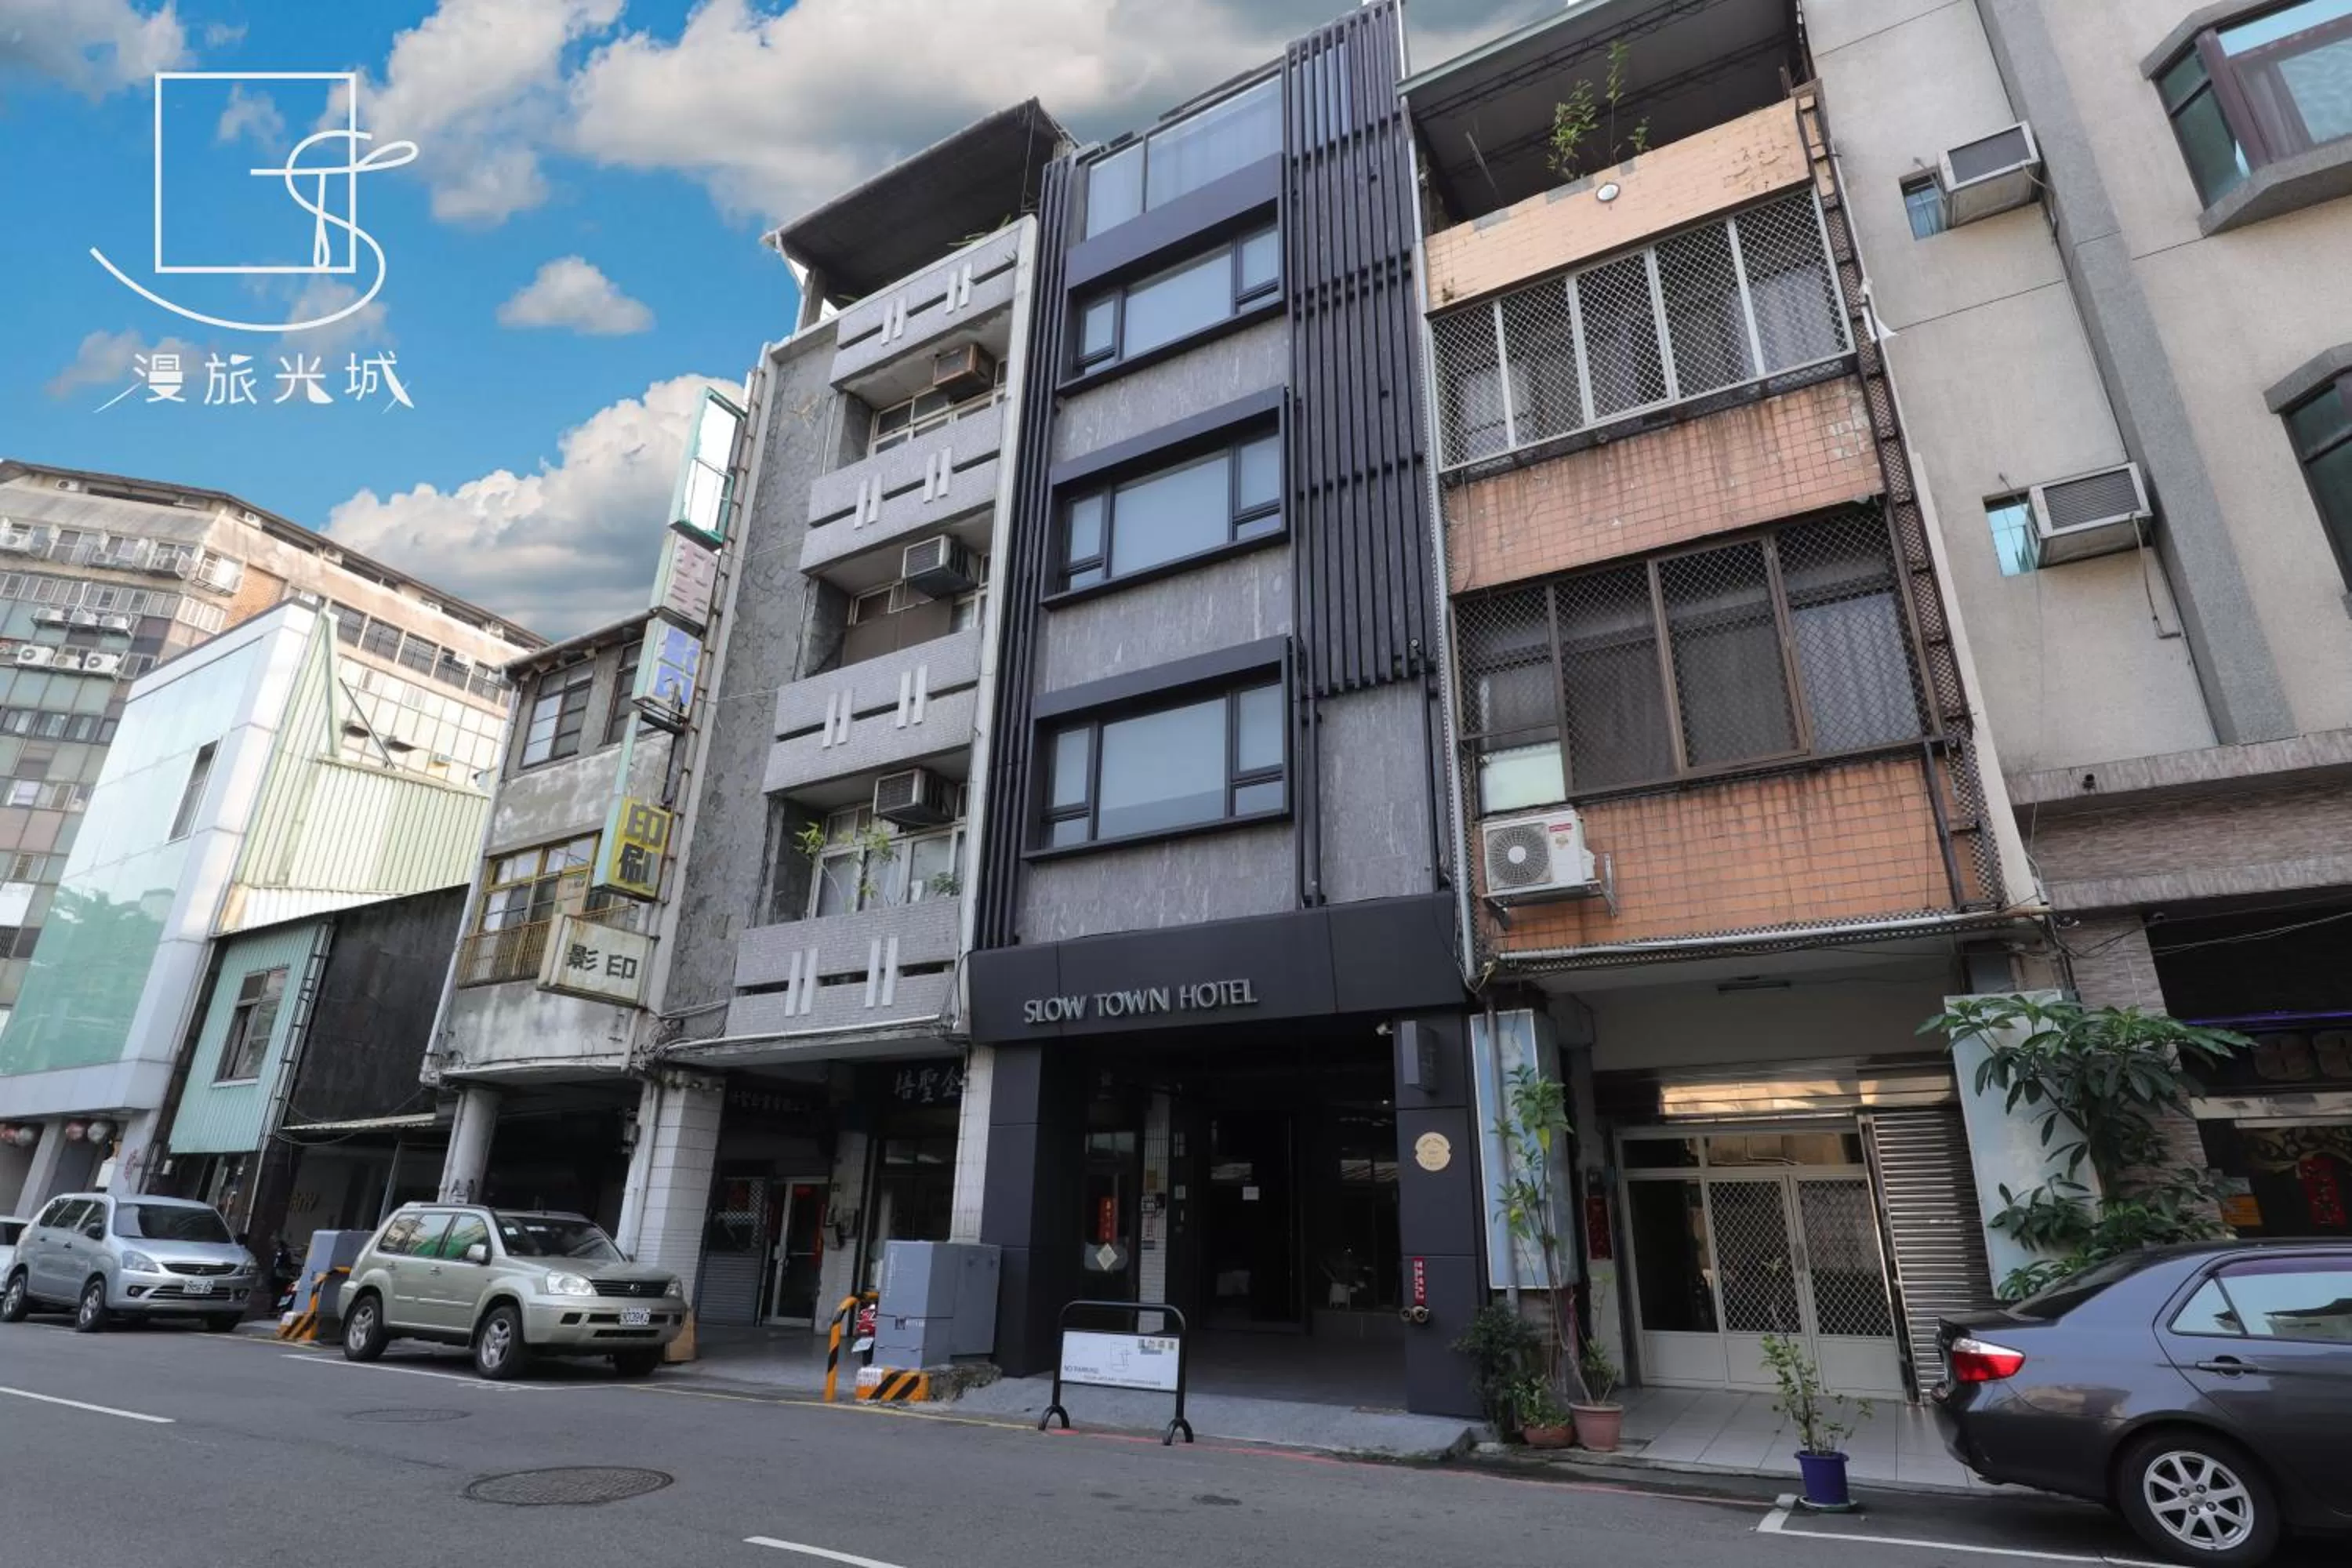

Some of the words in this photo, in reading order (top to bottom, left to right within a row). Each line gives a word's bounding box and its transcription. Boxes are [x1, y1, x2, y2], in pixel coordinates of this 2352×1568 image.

[567, 943, 637, 979] 影印
[1024, 994, 1087, 1023] SLOW
[1094, 986, 1172, 1018] TOWN
[1178, 978, 1259, 1011] HOTEL
